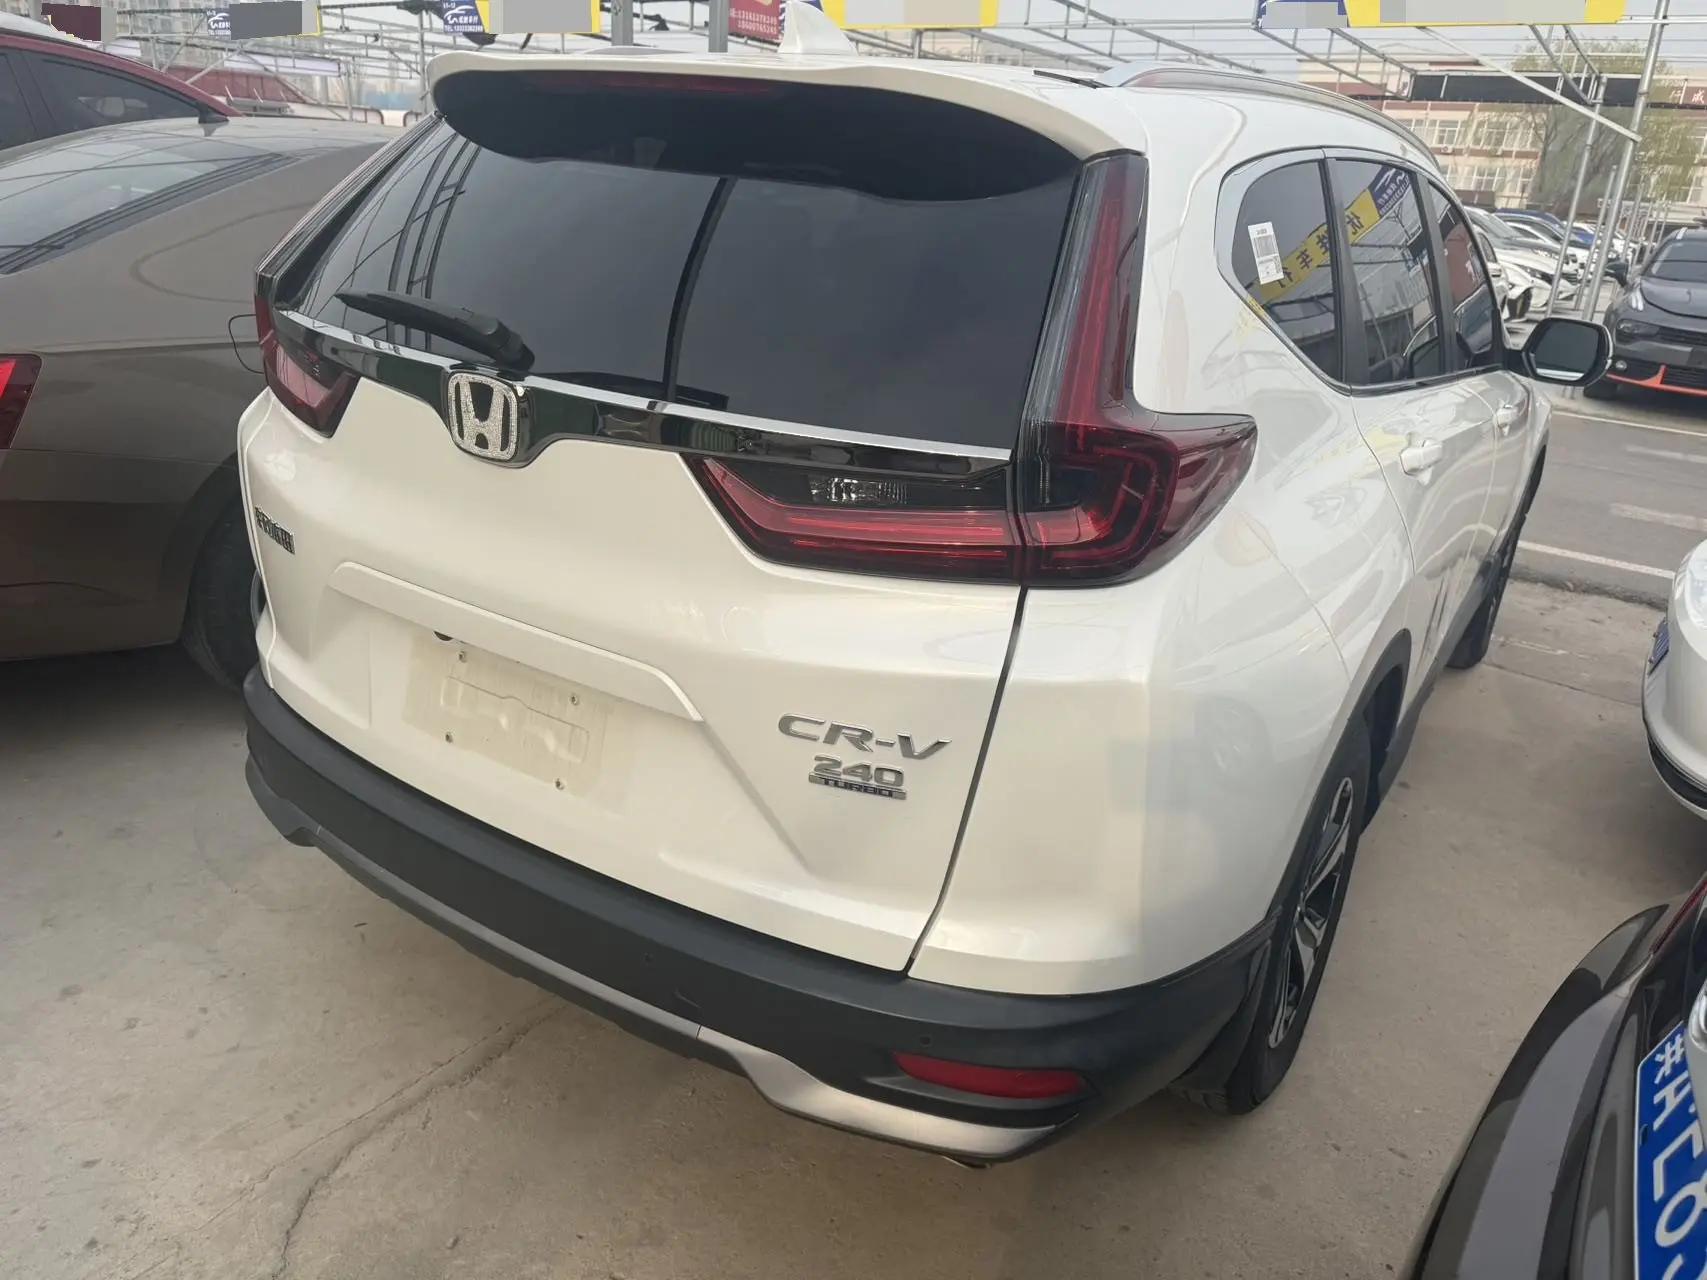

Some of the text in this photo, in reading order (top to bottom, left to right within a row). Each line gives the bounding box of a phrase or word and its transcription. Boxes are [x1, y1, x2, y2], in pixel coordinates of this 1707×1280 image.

[778, 713, 952, 760] CR-V
[814, 753, 904, 787] 240
[819, 777, 895, 798] TURBO
